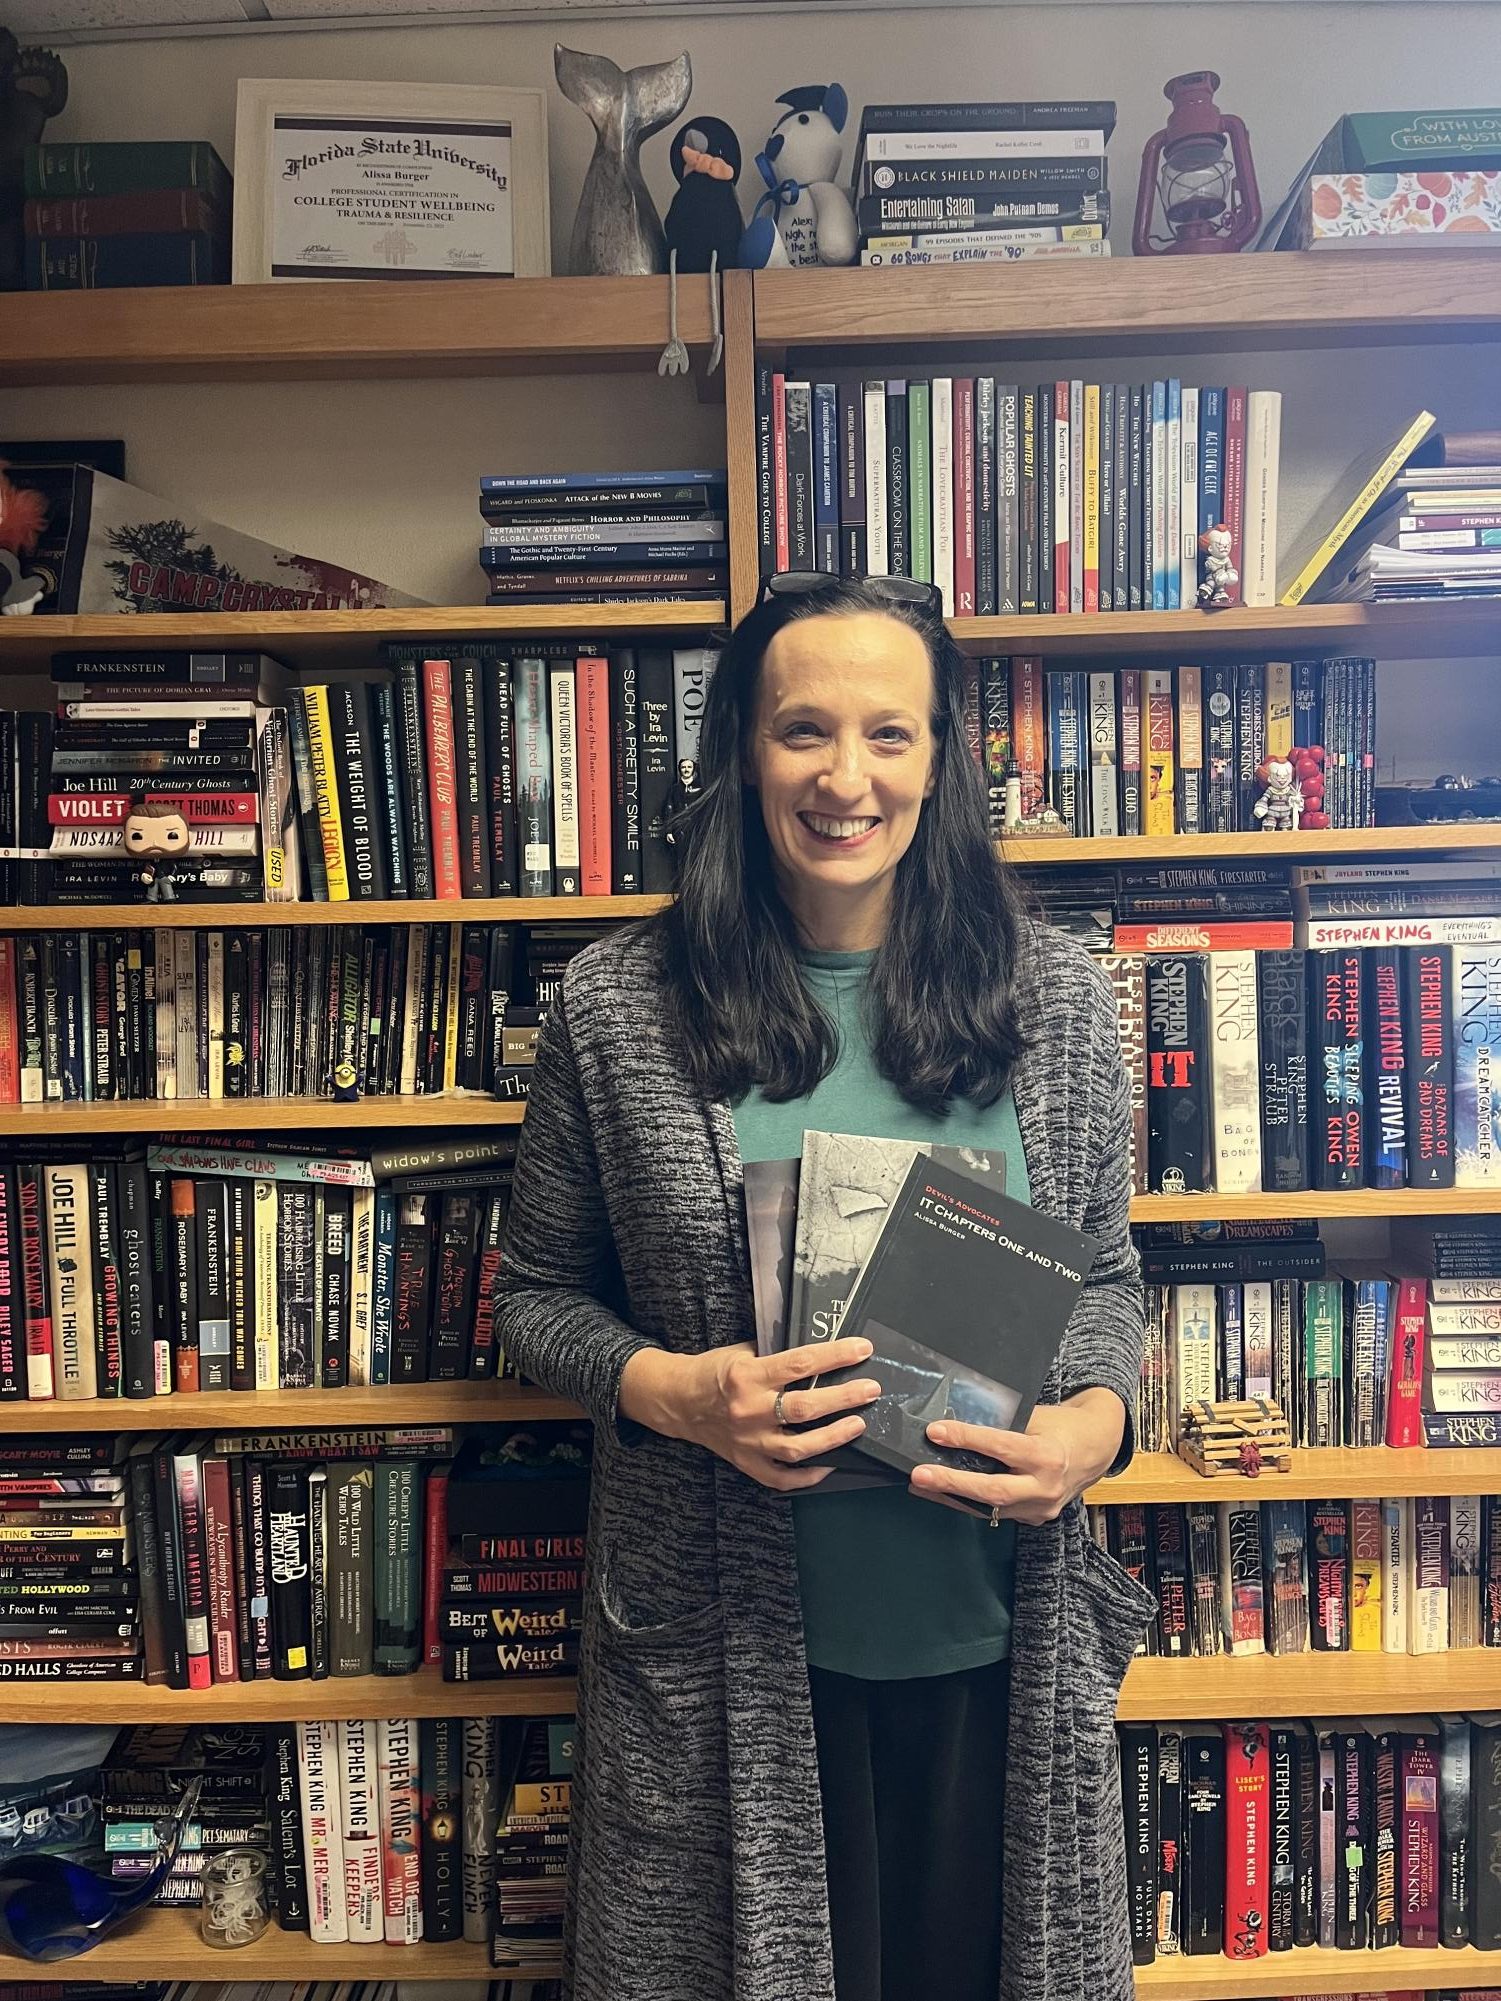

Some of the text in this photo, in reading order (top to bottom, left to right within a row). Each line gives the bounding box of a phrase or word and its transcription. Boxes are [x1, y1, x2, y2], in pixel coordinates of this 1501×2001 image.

[1403, 131, 1500, 145] FROM AUST
[1422, 120, 1468, 131] WITH
[282, 137, 507, 191] Florida State University
[362, 171, 430, 182] Alissa Burger
[898, 169, 1037, 182] BLACK SHIELD MAIDEN
[294, 197, 495, 212] COLLEGE STUDENT WELLBEING
[389, 190, 448, 198] CERTIFICATION
[881, 196, 975, 219] Entertaining Satan
[337, 210, 454, 221] TRAUMA & RESILIENCE
[993, 203, 1058, 216] John Putnam Demos
[1006, 396, 1015, 496] POPULAR GHOSTS
[761, 415, 770, 546] THE VAMPIRE GOES TO COLLEGE
[643, 514, 690, 522] PHILOSOPHY
[554, 546, 591, 557] Twenty-First
[593, 545, 618, 553] Century
[128, 561, 221, 607] CAMP
[77, 664, 165, 672] FRANKENSTEIN
[345, 691, 353, 726] JACKSON
[643, 702, 668, 711] Three
[650, 712, 660, 722] by
[643, 733, 668, 743] Levin
[649, 724, 661, 732] Ira
[173, 756, 221, 765] INVITED
[624, 669, 638, 851] SUCH A PRETTY SMILE
[64, 777, 231, 792] Joe Hill 20th Century Ghosts
[59, 800, 234, 817] VIOLET THOMAS
[346, 732, 371, 880] THE WEIGHT OF BLOOD
[1125, 787, 1137, 813] CUJO
[195, 831, 224, 845] HILL
[270, 850, 281, 882] USED
[1147, 932, 1210, 947] SEASONS
[1158, 927, 1200, 935] DIFFERENT
[1316, 925, 1431, 942] STEPHEN KING
[1150, 978, 1169, 1032] KING
[1163, 963, 1188, 1046] STEPHEN
[1326, 974, 1341, 1021] KING
[1345, 958, 1359, 1037] STEPHEN
[1420, 957, 1442, 1057] STEPHEN KING
[1377, 966, 1404, 1070] STEPHEN KING
[1150, 1051, 1194, 1088] IT
[1264, 1064, 1277, 1125] STRAUB
[1277, 1077, 1287, 1125] PETER
[1477, 1048, 1490, 1160] DREAMCATCHER
[1379, 1076, 1405, 1154] REVIVAL
[1328, 1117, 1342, 1163] KING
[1346, 1112, 1359, 1167] OWEN
[383, 1145, 499, 1170] widow's point
[52, 1173, 75, 1252] JOE HILL
[97, 1178, 110, 1259] PAUL TREMBLAY
[924, 1184, 1001, 1226] DEVIL'S ADVOCATES
[913, 1211, 965, 1240] ALISSA BURGER
[919, 1197, 1082, 1282] IT CHAPTERS ONE AND TWO
[208, 1208, 218, 1296] FRANKENSTEIN
[1212, 1262, 1234, 1270] KING
[1277, 1258, 1320, 1266] OUTSIDER
[123, 1229, 143, 1335] ghost eaters
[328, 1214, 342, 1341] BREED CHASE NOVAK
[375, 1242, 391, 1353] Monster, She Wrote
[61, 1277, 79, 1379] FULL THROTTLE
[105, 1265, 119, 1378] GROWING THINGS
[241, 1431, 387, 1450] FRANKENSTEIN
[480, 1538, 583, 1559] FINAL GIRLS
[22, 1585, 89, 1594] HOLLYWOOD
[451, 1584, 471, 1592] THOMAS
[453, 1575, 469, 1583] SCOTT
[478, 1571, 577, 1592] MIDWESTERN
[9, 1605, 58, 1615] FROM EVIL
[449, 1610, 487, 1637] BEST OF
[491, 1608, 567, 1637] Weird
[15, 1663, 60, 1675] HALLS
[497, 1644, 565, 1670] Weird
[436, 1723, 448, 1810] STEPHEN KING
[1236, 1775, 1265, 1784] LISEY'S
[1138, 1747, 1149, 1854] STEPHEN KING
[1276, 1753, 1290, 1865] STEPHEN KING
[1246, 1801, 1256, 1886] STEPHEN KING
[1408, 1820, 1420, 1913] STEPHEN KING
[388, 1876, 404, 1916] WATCH
[436, 1853, 450, 1917] HOLLY
